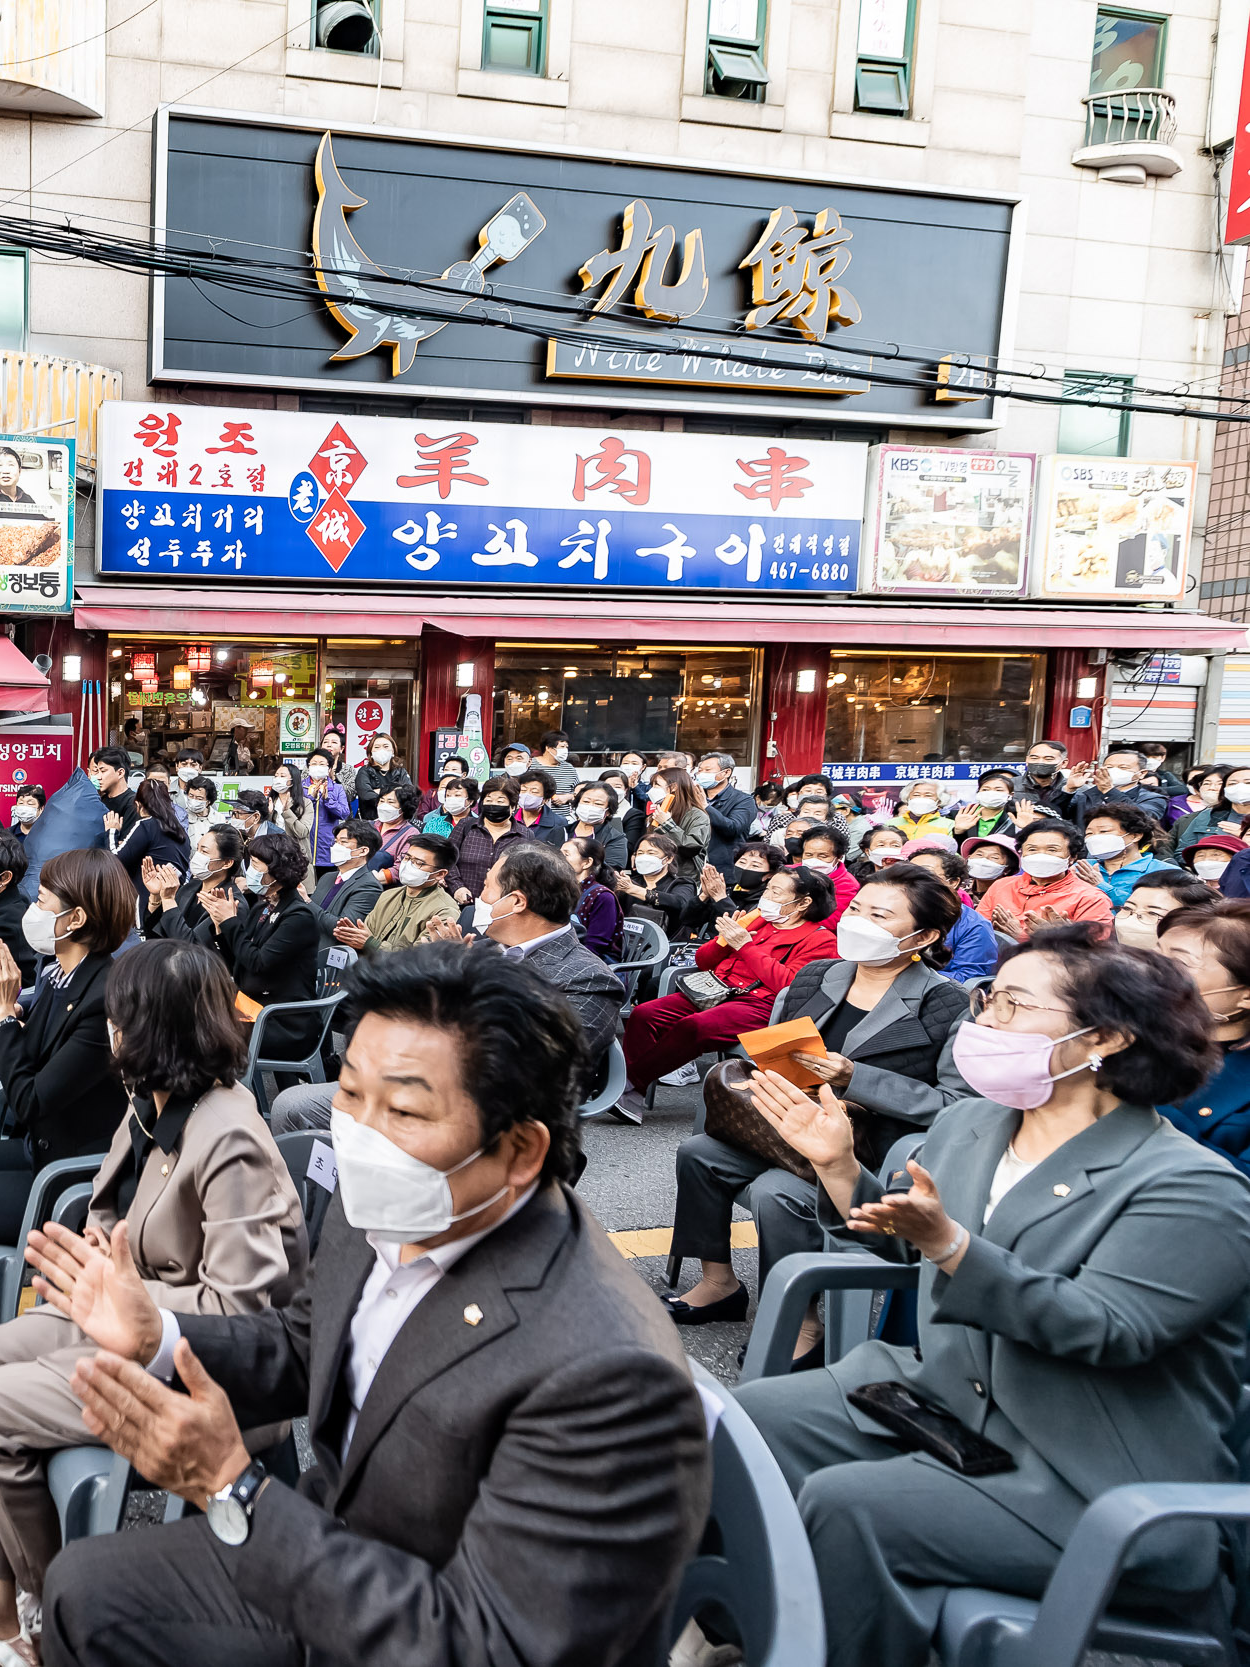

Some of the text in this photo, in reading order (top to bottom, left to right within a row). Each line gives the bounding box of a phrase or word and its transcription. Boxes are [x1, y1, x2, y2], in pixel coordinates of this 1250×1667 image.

[575, 341, 663, 372] Nine
[133, 411, 258, 458] 원조
[123, 458, 267, 493] 건대2호점
[396, 432, 814, 511] 羊肉串
[891, 458, 919, 472] KBS
[120, 499, 264, 536] 양꼬치거리
[126, 537, 248, 571] 선두주자
[392, 510, 766, 583] 양꼬치구이
[769, 562, 849, 581] 467-6880
[357, 708, 381, 723] 원조
[822, 765, 881, 780] 京城羊肉串
[895, 764, 955, 780] 京城羊肉串
